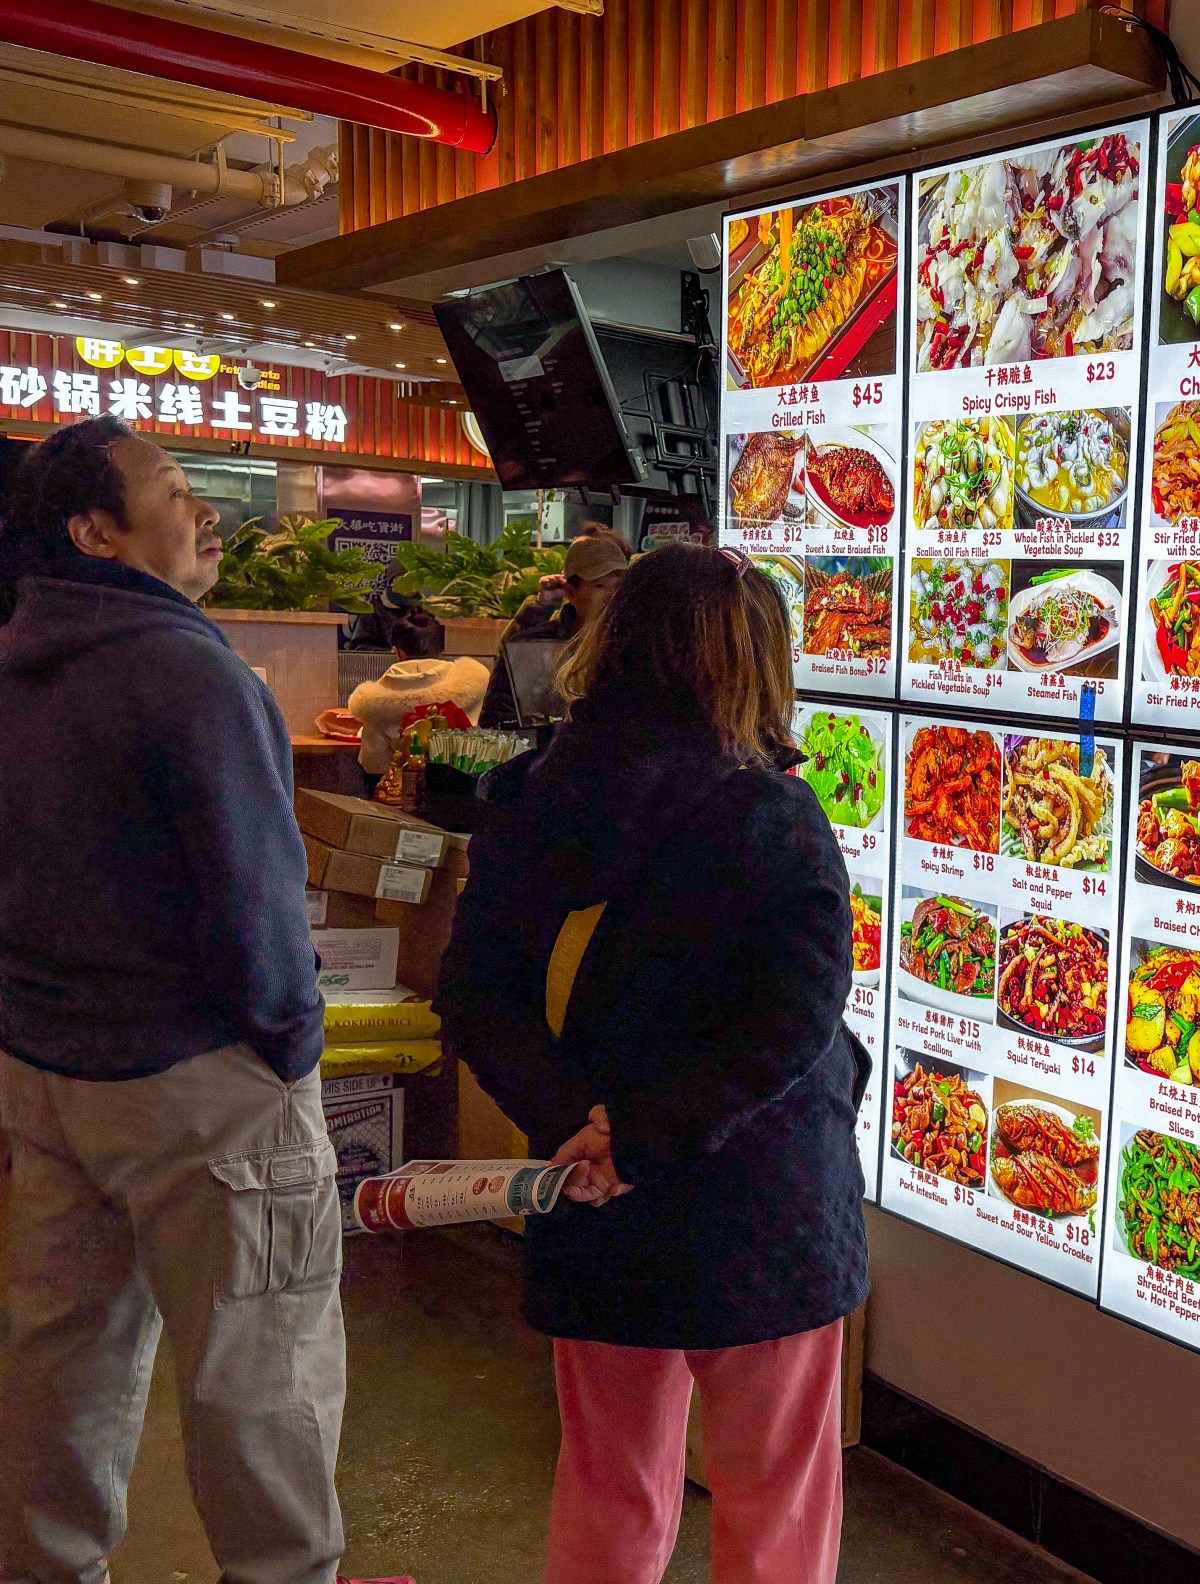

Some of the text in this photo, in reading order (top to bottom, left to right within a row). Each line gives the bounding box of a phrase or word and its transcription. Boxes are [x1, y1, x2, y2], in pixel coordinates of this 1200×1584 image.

[1087, 362, 1114, 383] $23
[778, 384, 819, 406] 大盘烤鱼
[853, 383, 882, 408] $45
[963, 388, 1056, 414] Spicy Crispy Fish
[772, 409, 825, 427] Grilled Fish
[868, 527, 887, 544] $18
[983, 532, 1001, 546] $25
[1098, 532, 1119, 547] $32
[806, 544, 885, 554] Sweet & Sour Braised Fish
[917, 547, 988, 557] Scallion Oil Fish Fillet
[812, 663, 867, 676] Braised Fish Bones
[867, 658, 886, 674] $12
[929, 670, 942, 680] Fish
[944, 672, 964, 682] Fillets
[986, 674, 1002, 688] $14
[912, 679, 990, 698] Pickled Vegetable Soup
[1028, 687, 1077, 701] Steamed Fish
[1147, 694, 1163, 705] Stir
[1166, 696, 1188, 707] Fried
[863, 834, 876, 849] $9
[921, 860, 964, 879] Spicy Shrimp
[974, 853, 994, 871] $18
[1012, 878, 1072, 900] Salt and Pepper
[1083, 876, 1106, 896] $14
[1031, 897, 1052, 911] Squid
[1154, 917, 1186, 933] Braised
[1007, 1050, 1060, 1075] Squid Teriyaki
[1072, 1056, 1094, 1076] $14
[324, 1082, 340, 1095] HIS
[342, 1079, 366, 1093] SIDE
[1150, 1098, 1182, 1117] Braised
[1169, 1121, 1194, 1138] Slices
[900, 1178, 948, 1206] Pork Intestines
[954, 1186, 974, 1206] $15
[1066, 1223, 1089, 1246] $18
